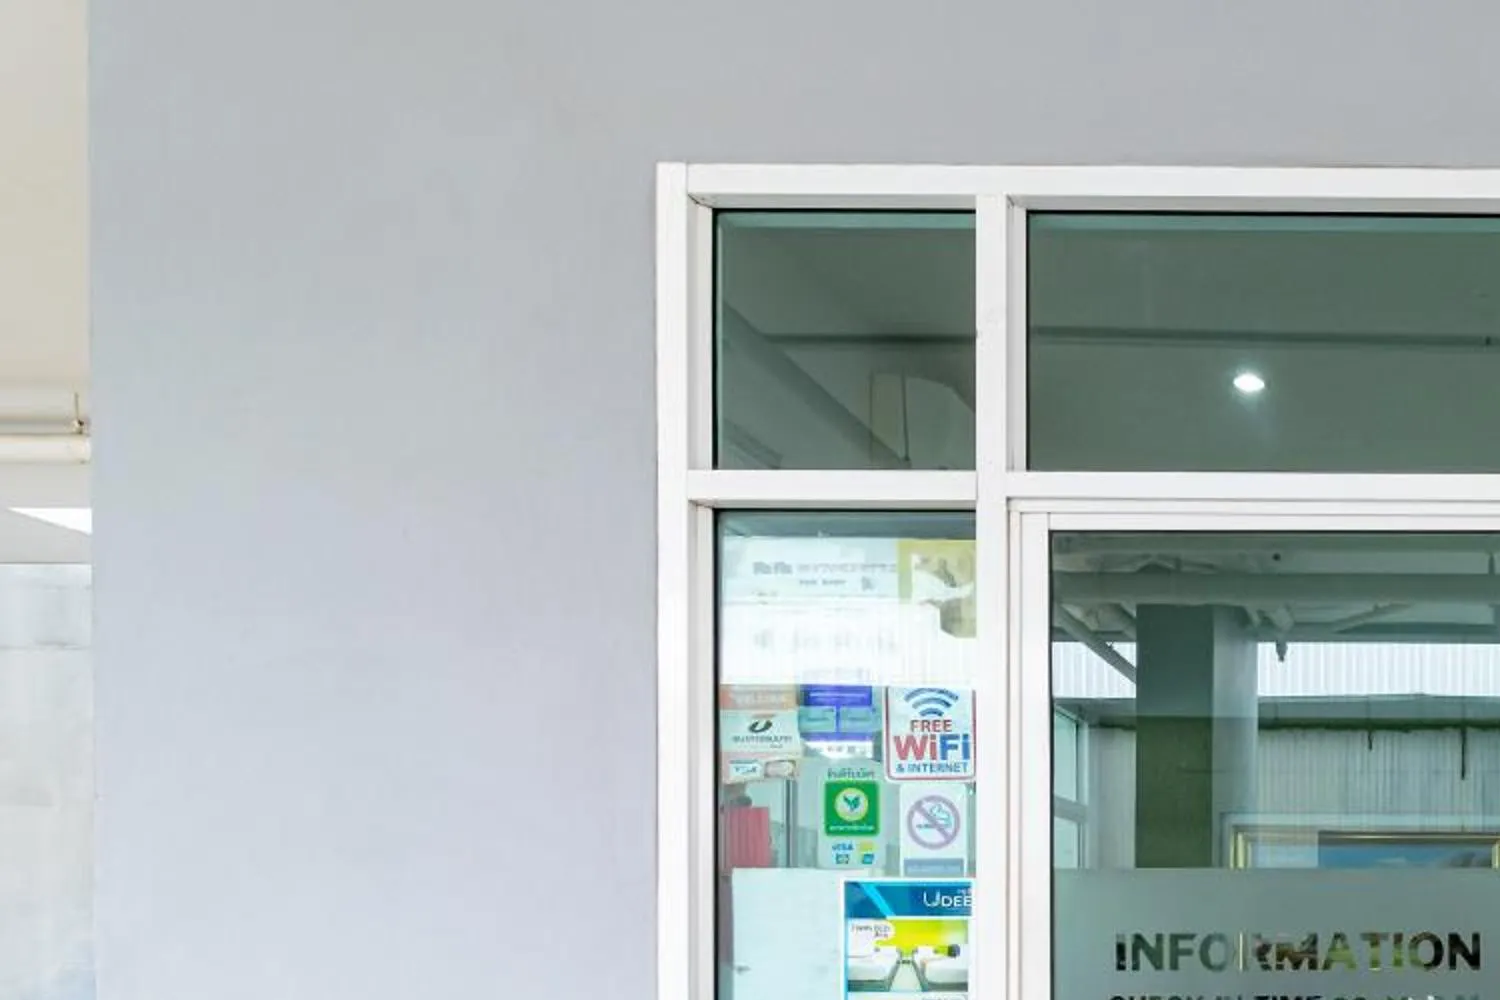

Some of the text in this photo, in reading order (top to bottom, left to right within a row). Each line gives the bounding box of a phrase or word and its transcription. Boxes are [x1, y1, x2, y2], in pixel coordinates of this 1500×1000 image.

[910, 719, 952, 733] FREE
[894, 733, 970, 761] WiFi
[896, 763, 968, 774] & INTERNET
[1115, 932, 1482, 972] INFORMATION
